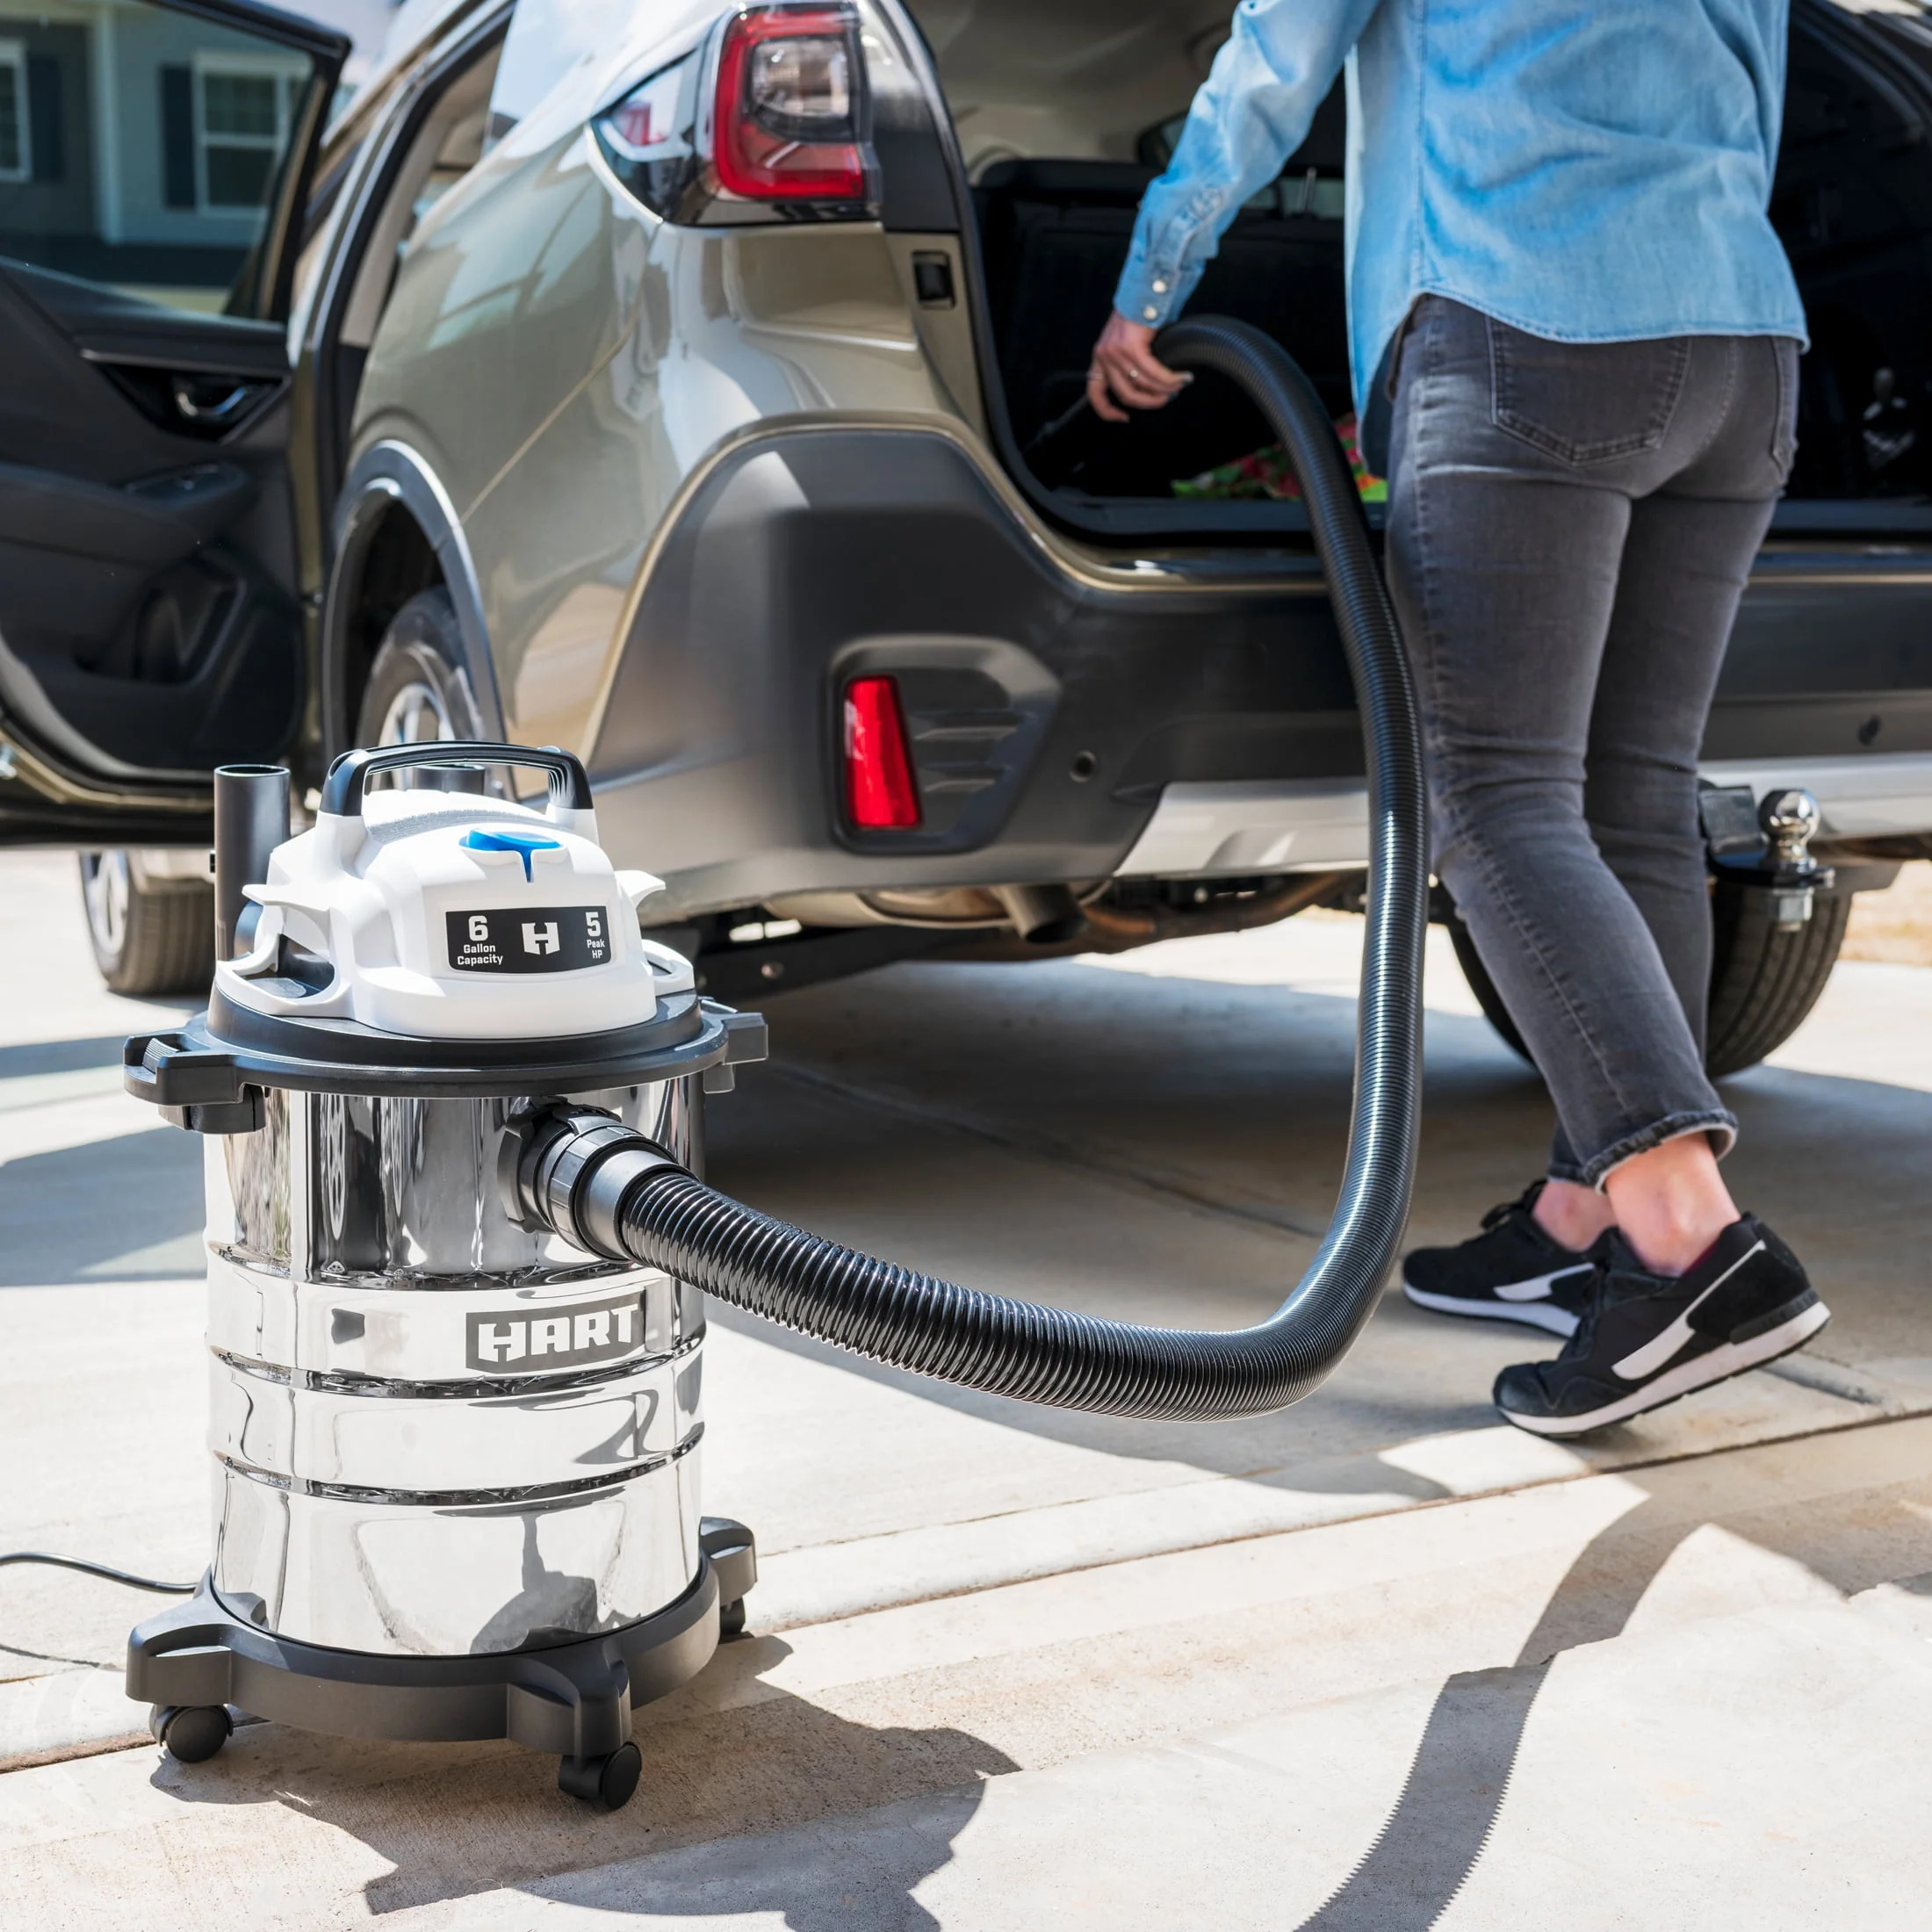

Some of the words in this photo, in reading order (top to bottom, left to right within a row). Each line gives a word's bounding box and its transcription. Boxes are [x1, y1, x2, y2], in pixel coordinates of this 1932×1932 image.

[468, 915, 488, 941] 6
[585, 911, 601, 937] 5
[464, 943, 495, 954] Gallon
[587, 939, 605, 948] Peak
[592, 949, 602, 959] HP
[457, 955, 503, 966] Capacity
[479, 1304, 638, 1362] HART
